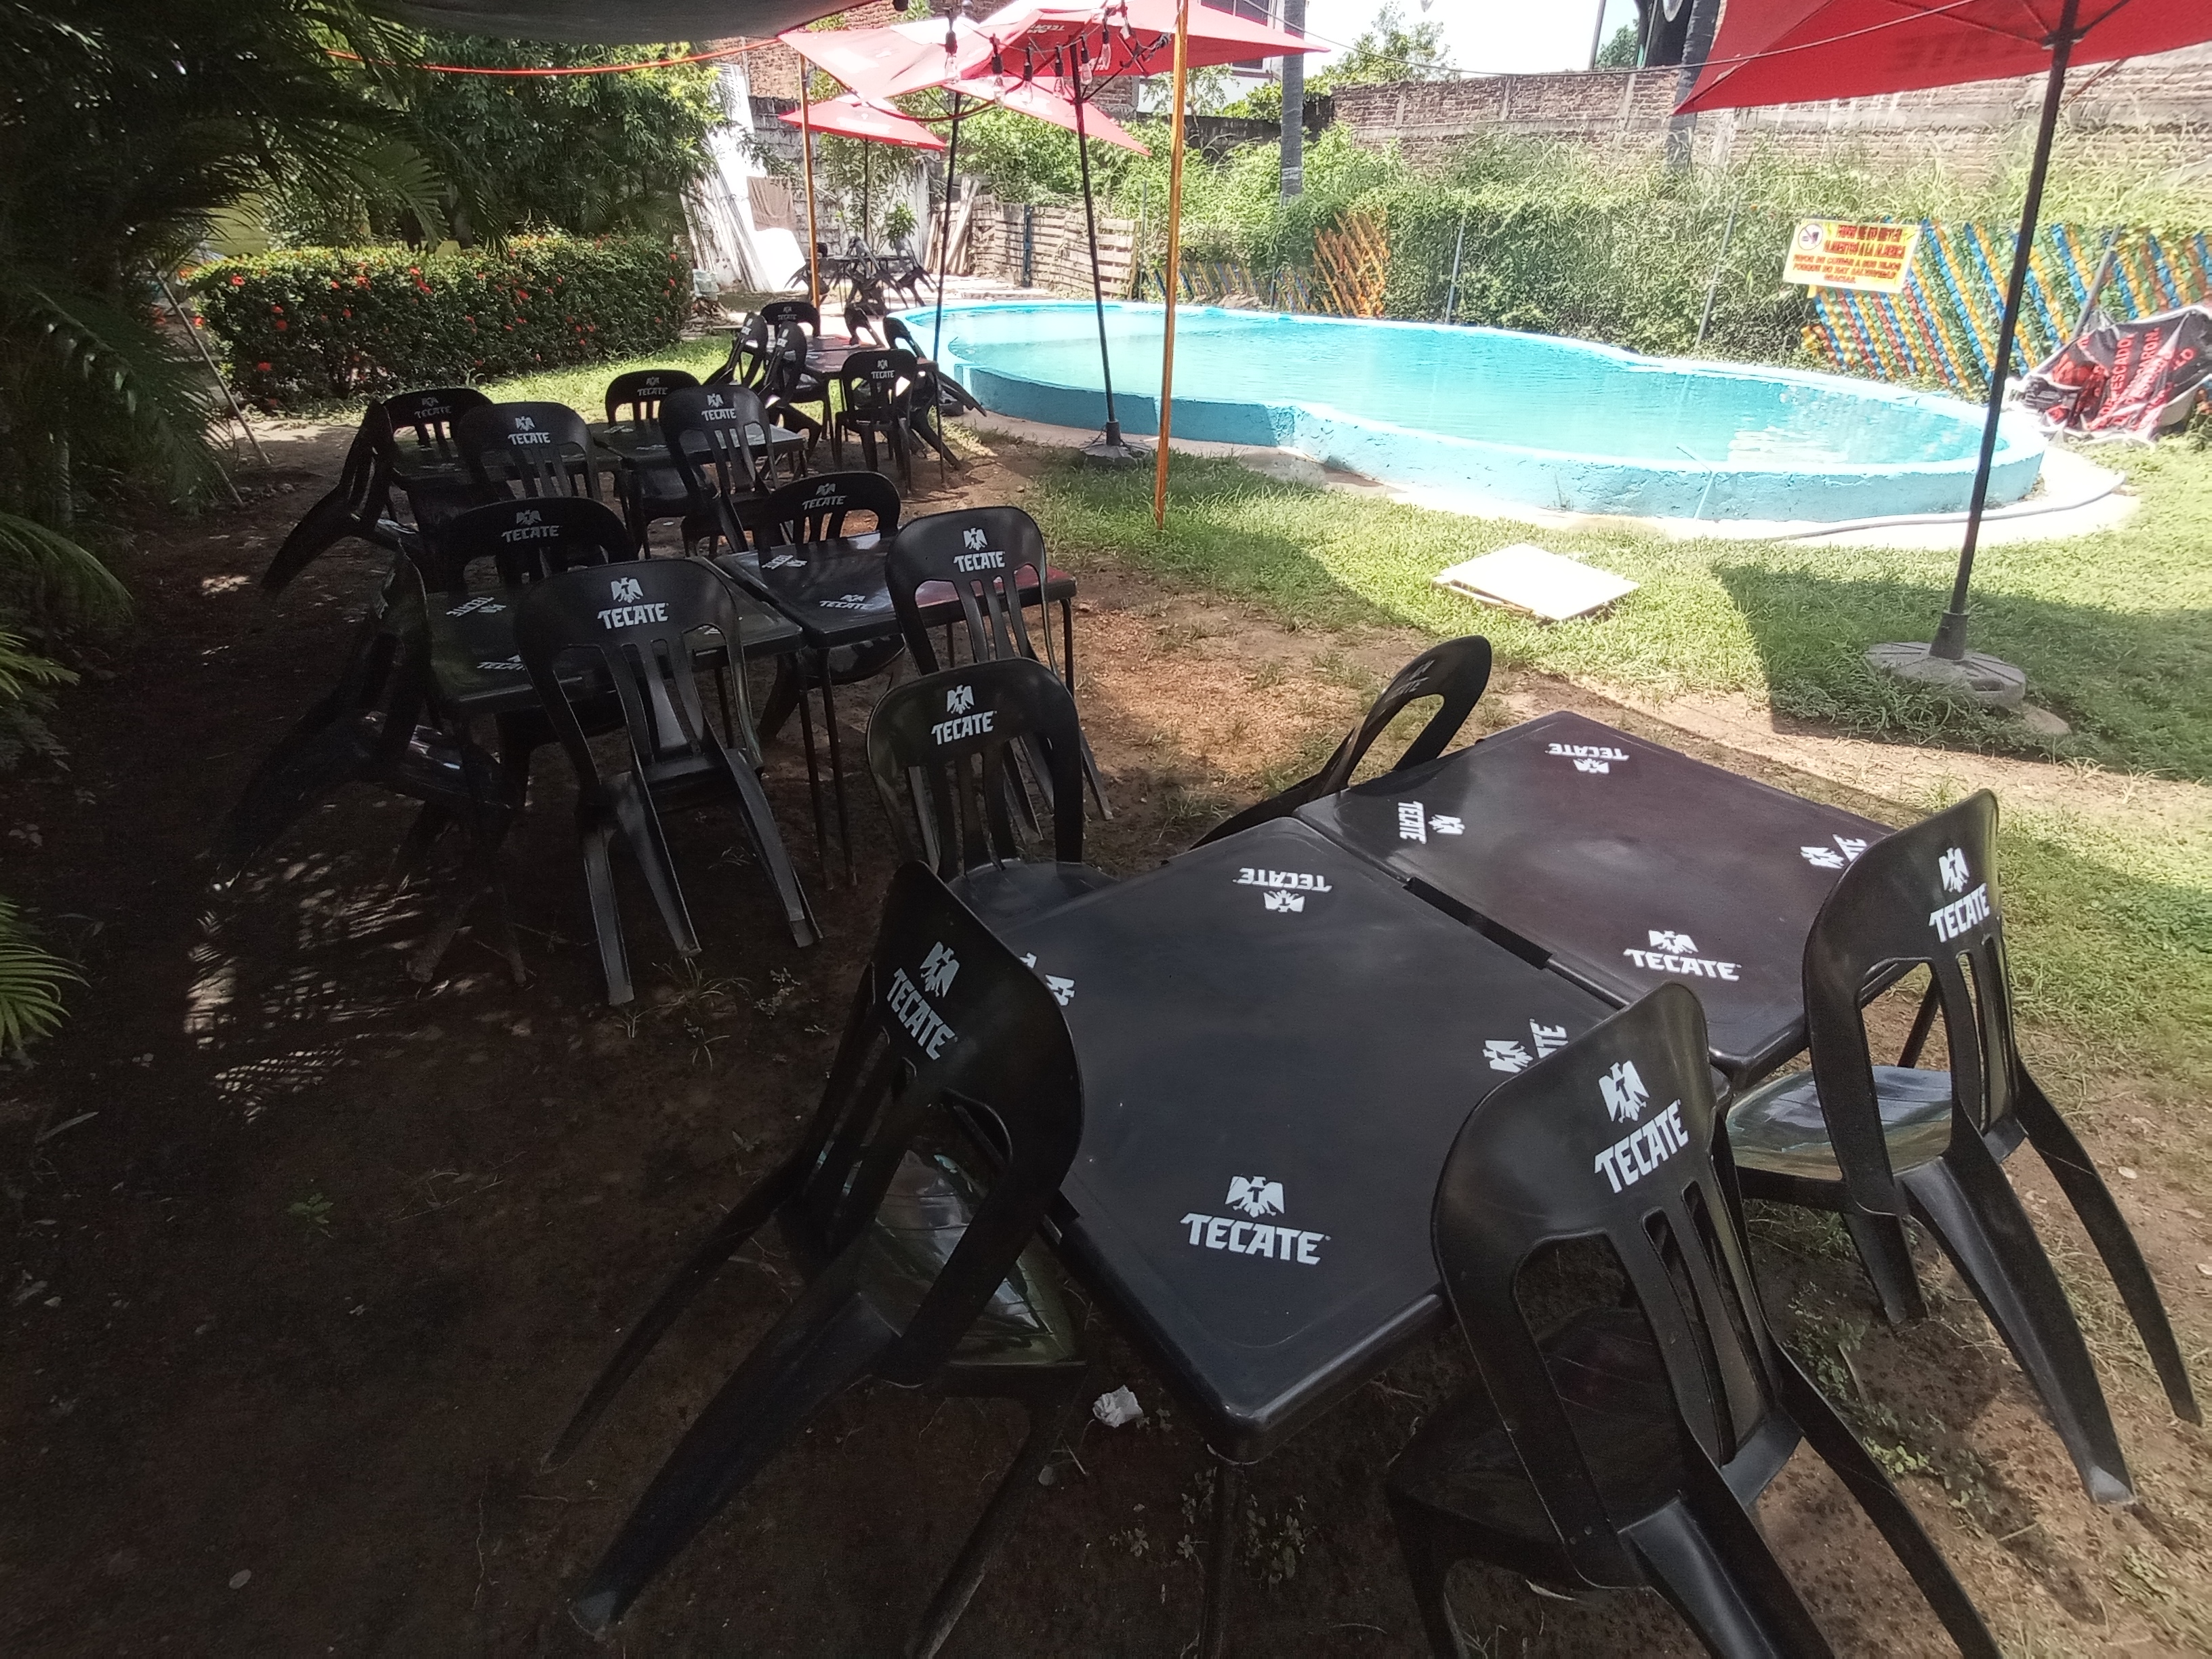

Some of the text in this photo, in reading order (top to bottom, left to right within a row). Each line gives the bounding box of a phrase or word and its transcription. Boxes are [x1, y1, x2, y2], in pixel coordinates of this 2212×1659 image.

[871, 370, 895, 380] TECATE
[637, 387, 668, 396] TECATE
[413, 407, 451, 419] TECATE
[701, 408, 737, 422] TECATE
[508, 432, 551, 445] TECATE
[802, 495, 848, 510] TECATE
[501, 524, 562, 543] TECATE
[953, 550, 1006, 573] TECATE
[597, 602, 669, 630] TECATE
[819, 600, 874, 610] TECATE
[931, 710, 997, 745] TECATE
[1544, 743, 1629, 762] TECATE
[1397, 801, 1427, 844] TECATE
[1233, 867, 1332, 893] TECATE
[1928, 882, 1990, 943] TECATE
[1624, 949, 1742, 981] TECATE
[886, 968, 958, 1061] TECATE
[1595, 1099, 1689, 1194] TECATE
[1181, 1213, 1331, 1265] TECATE
